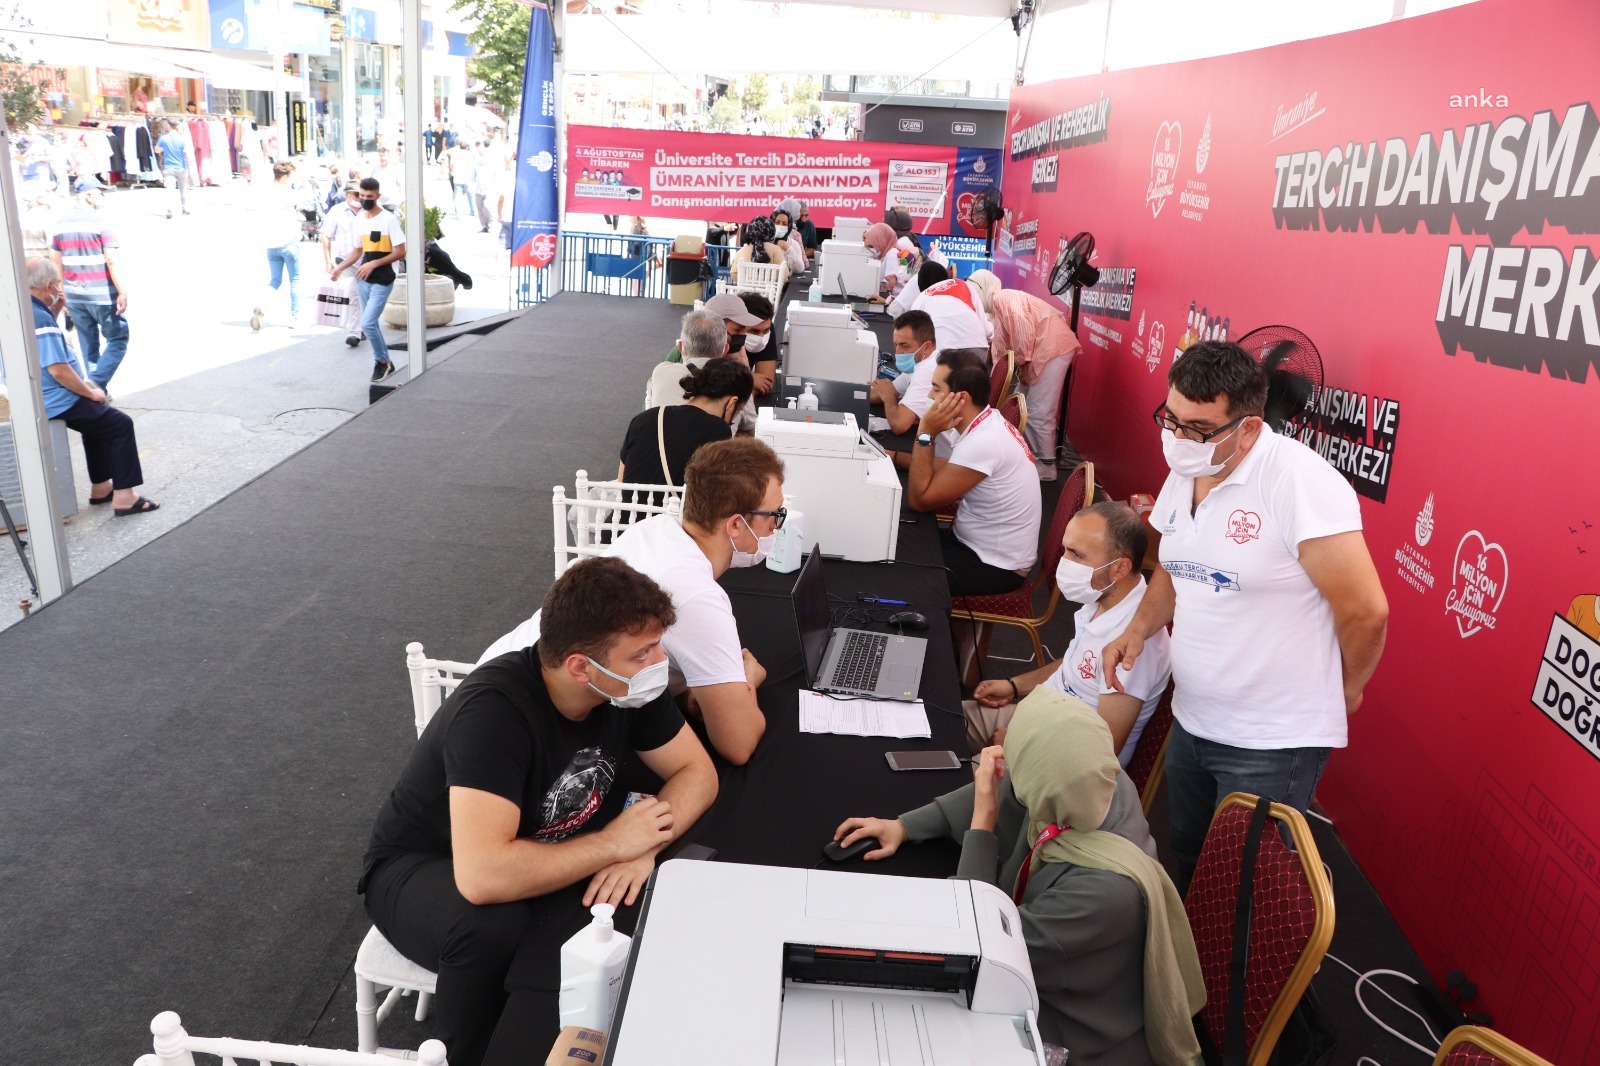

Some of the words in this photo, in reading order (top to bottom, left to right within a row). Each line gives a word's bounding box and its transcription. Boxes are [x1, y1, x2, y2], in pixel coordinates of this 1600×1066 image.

[1050, 114, 1061, 142] VE
[1060, 90, 1110, 140] REHBERLİK
[1272, 90, 1318, 136] Ümraniye
[583, 148, 644, 158] AĞUSTOS'TAN
[655, 149, 732, 166] Üniversite
[736, 152, 781, 166] Tercih
[784, 153, 871, 167] Döneminde
[590, 158, 629, 168] İTİBAREN
[1032, 153, 1058, 184] MERKEZİ
[656, 170, 746, 187] ÜMRANİYE
[750, 174, 873, 188] MEYDANI'NDA
[652, 195, 779, 208] Danışmanlarımızla
[1127, 268, 1136, 286] VE
[1106, 289, 1134, 312] MERKEZİ
[1373, 398, 1398, 434] VE
[1403, 542, 1431, 569] İSTANBUL
[1477, 554, 1488, 571] 16
[1185, 564, 1206, 573] TERCİH
[1395, 549, 1435, 588] BÜYÜKŞEHİR
[1398, 568, 1425, 594] BELEDİYESİ
[576, 1049, 590, 1057] 200
